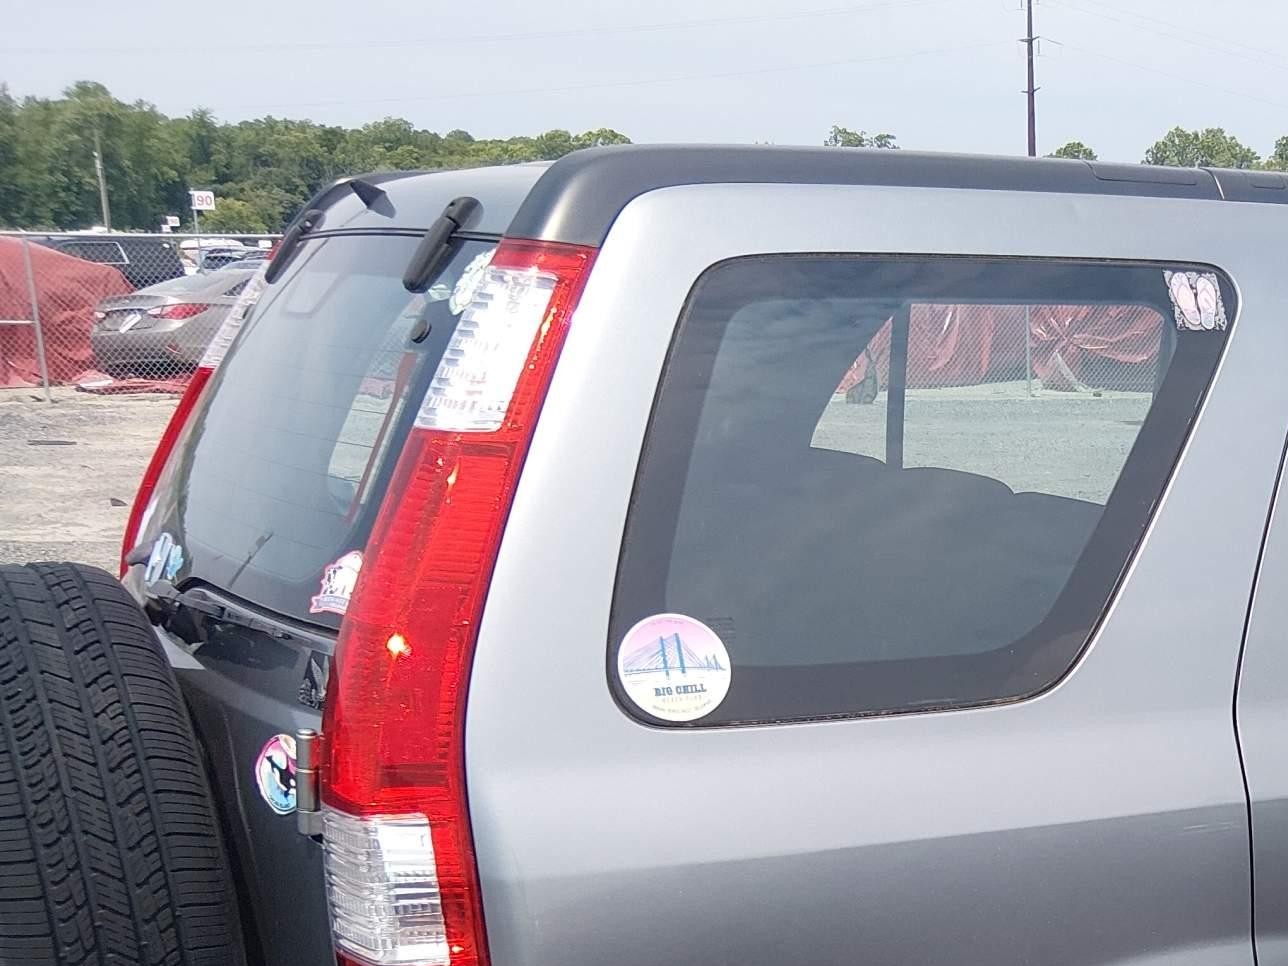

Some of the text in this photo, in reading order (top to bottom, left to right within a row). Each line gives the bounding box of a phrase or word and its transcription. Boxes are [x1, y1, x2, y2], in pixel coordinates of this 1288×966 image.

[196, 195, 213, 206] 90
[654, 683, 707, 697] BIG CHILL
